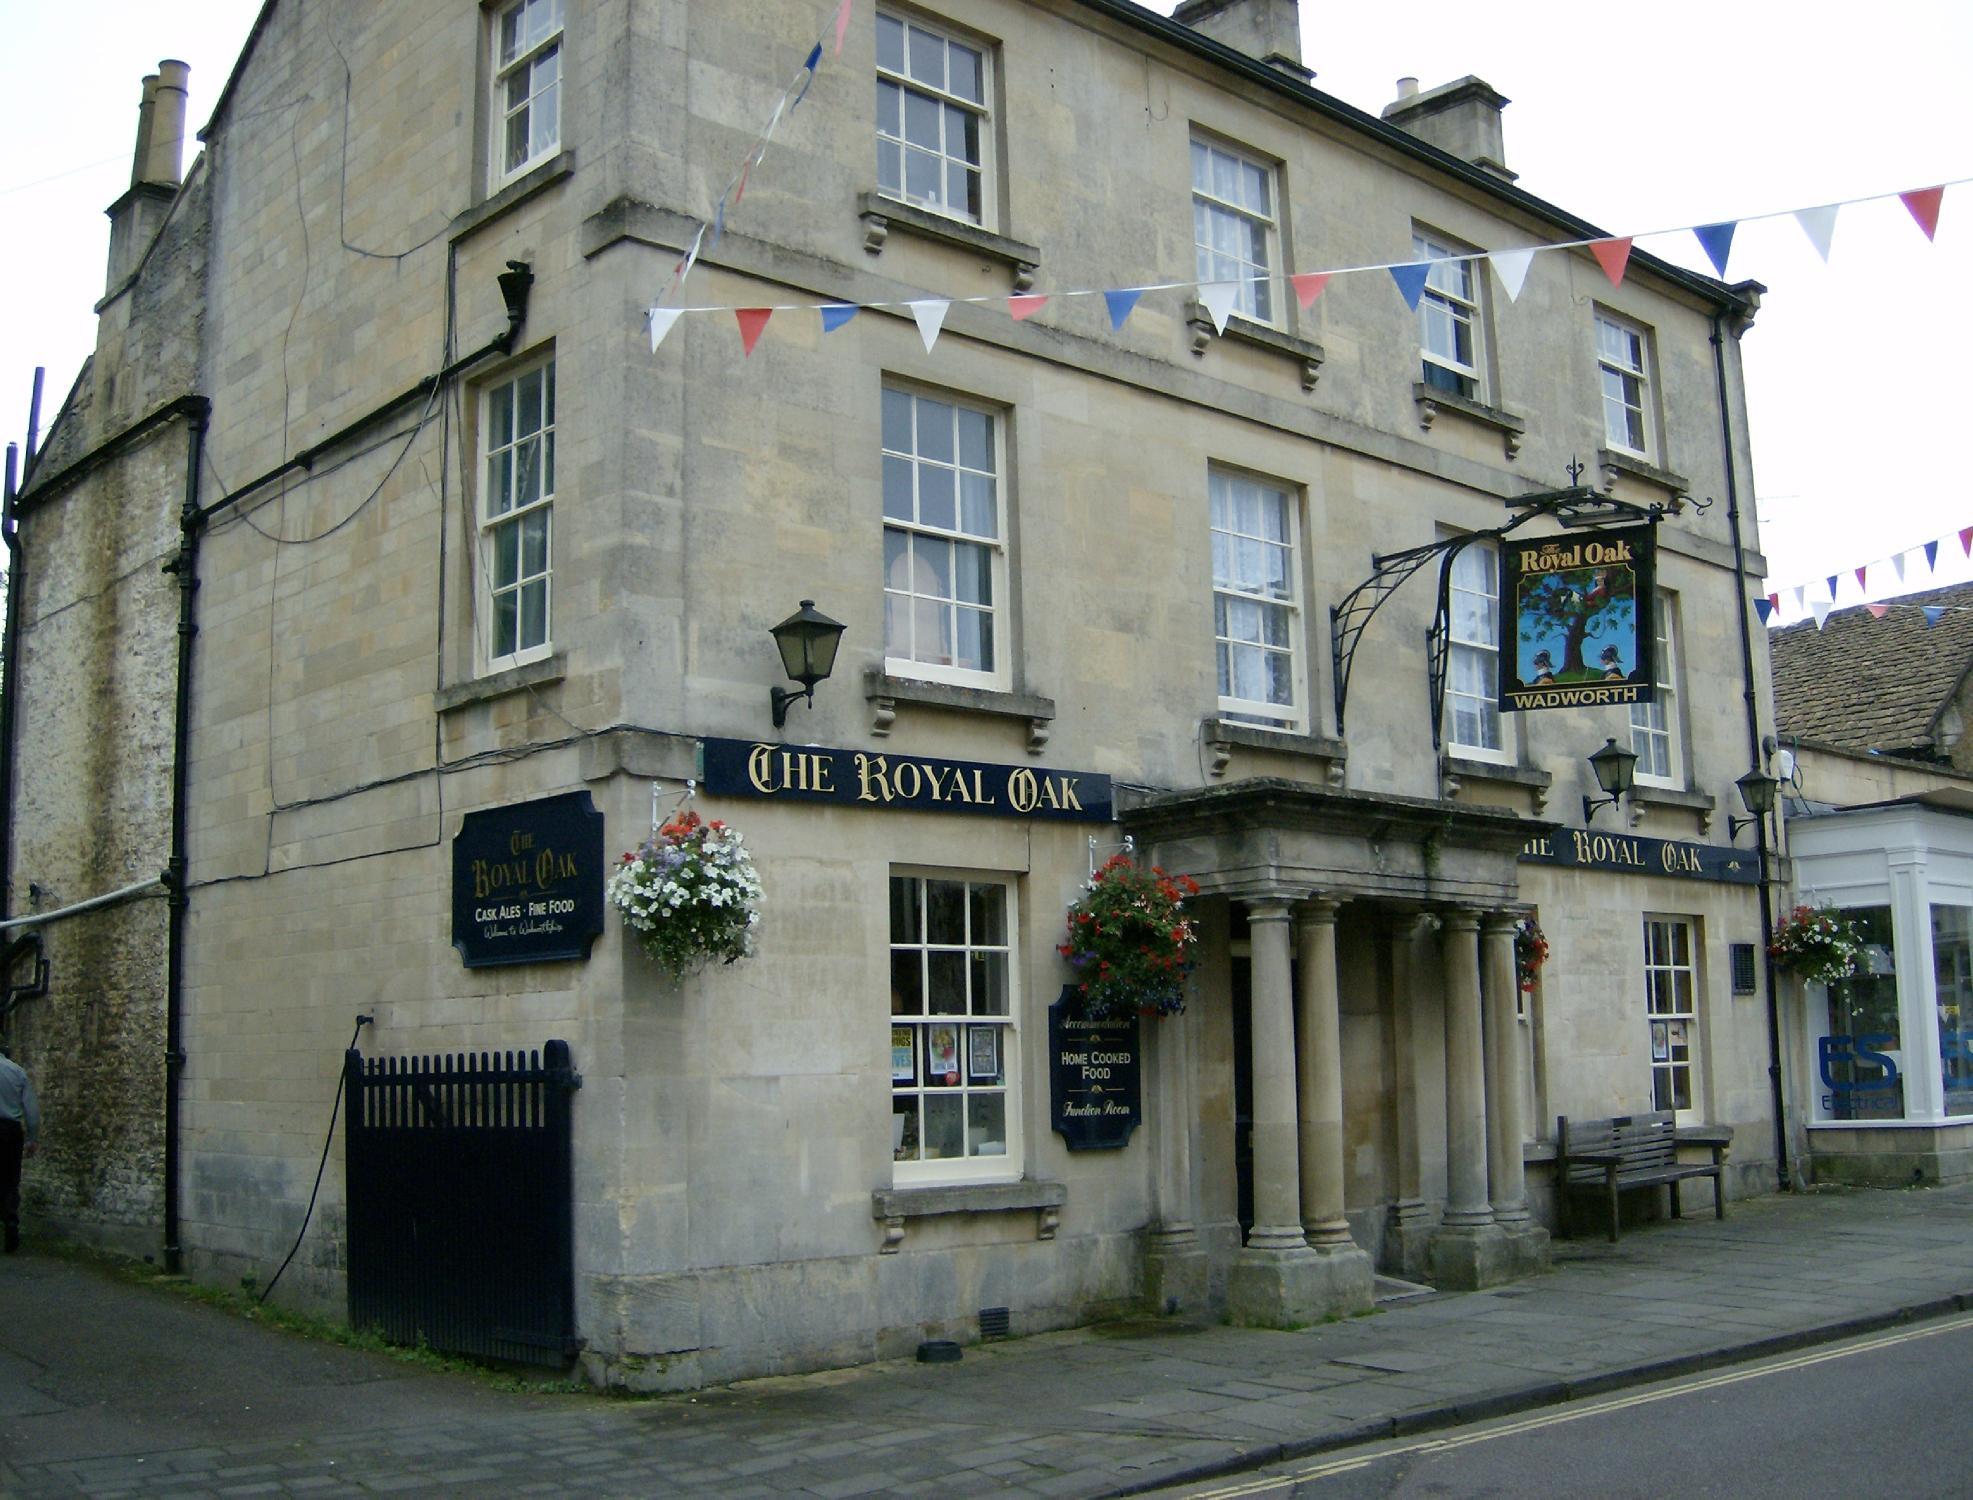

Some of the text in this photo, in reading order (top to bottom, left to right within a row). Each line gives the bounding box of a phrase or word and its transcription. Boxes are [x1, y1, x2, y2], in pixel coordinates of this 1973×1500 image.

[1519, 540, 1633, 572] Royal Oak
[1514, 687, 1637, 709] WADWORTH
[748, 743, 1083, 813] THE ROYAL OAK
[1523, 830, 1703, 873] HE ROYAL OAK
[472, 848, 577, 898] ROYAL OAK
[475, 900, 575, 922] CASK ALES FINE FOOD
[1061, 1051, 1131, 1065] HOME COOKED
[1082, 1066, 1111, 1080] FOOD
[1063, 1100, 1130, 1117] Function Room
